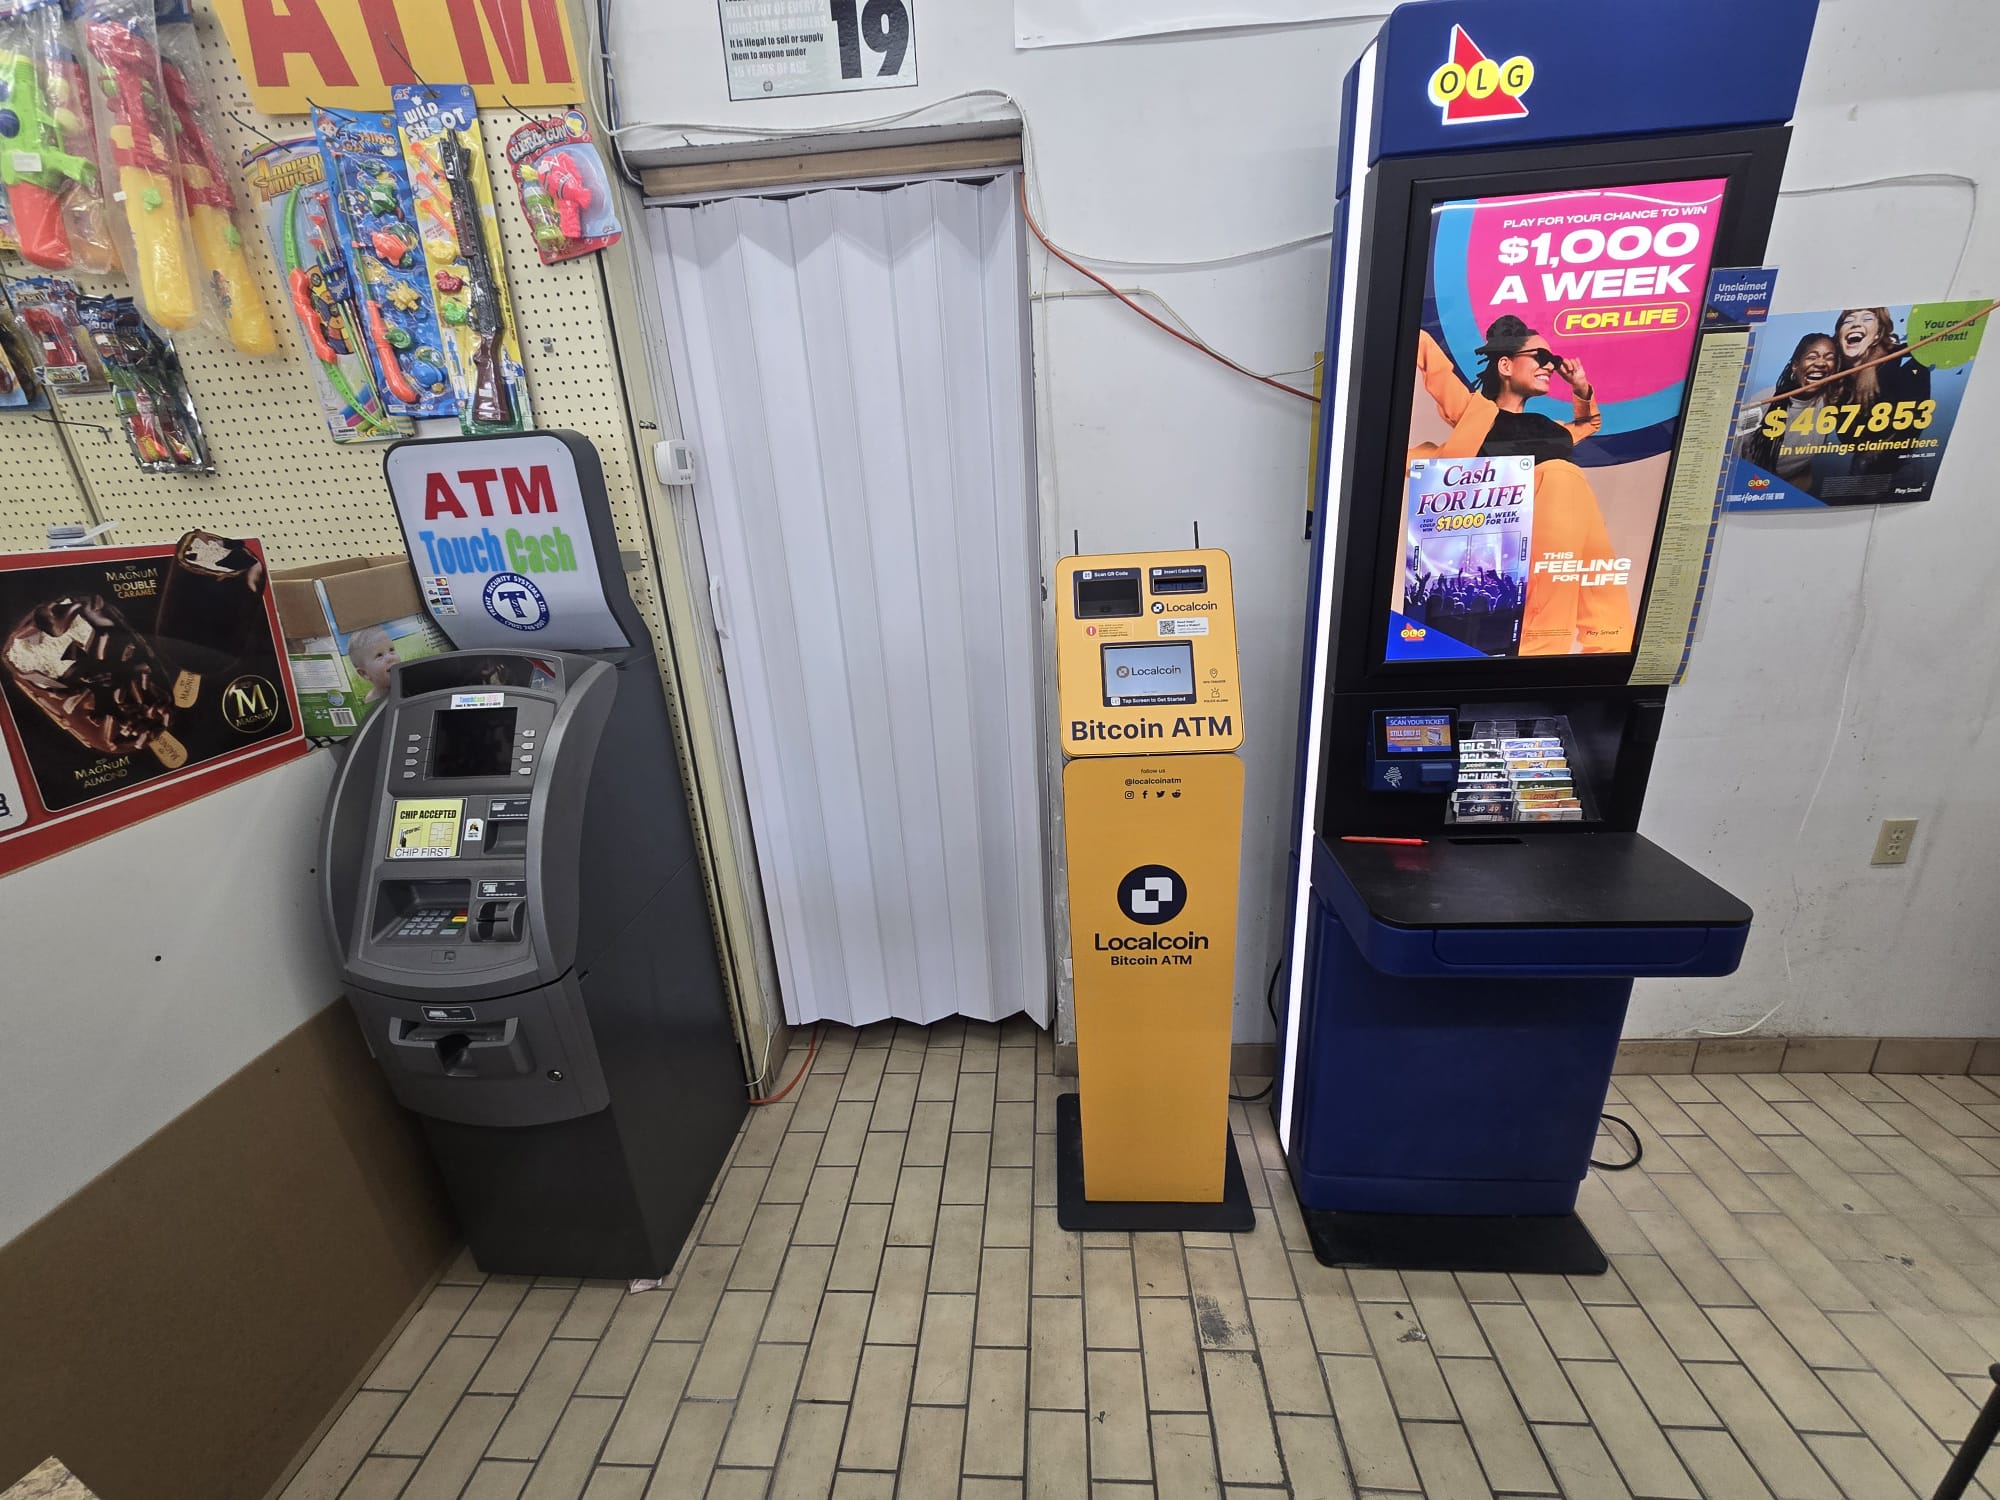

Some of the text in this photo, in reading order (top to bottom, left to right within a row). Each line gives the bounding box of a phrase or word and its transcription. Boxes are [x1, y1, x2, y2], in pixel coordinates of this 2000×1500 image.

[730, 32, 824, 48] It is illegal to sell or supply
[830, 0, 910, 80] 19
[731, 47, 807, 61] them to anyone under
[1440, 64, 1524, 94] OLG
[403, 102, 440, 125] WILD
[546, 126, 567, 144] GUN
[1503, 205, 1708, 229] PLAY FOR YOUR CHANCE TO WIN
[1497, 222, 1700, 269] $1,000
[1489, 263, 1696, 305] A WEEK
[1718, 281, 1768, 292] Unclaimed
[1714, 292, 1767, 304] Prize Report
[1565, 307, 1679, 330] FOR LIFE
[1924, 320, 1945, 330] You
[1940, 331, 1969, 342] next!
[1780, 444, 1792, 456] in
[1794, 441, 1856, 456] winnings
[1857, 438, 1909, 452] claimed
[1443, 460, 1496, 487] Cash
[424, 465, 559, 521] ATM
[1417, 484, 1526, 515] FOR LIFE
[418, 526, 578, 576] Touch Cash
[1543, 552, 1574, 560] THIS
[105, 567, 159, 582] MAGNUM
[1534, 558, 1632, 574] FEELING
[113, 579, 157, 592] DOUBLE
[486, 575, 511, 594] SECURITY
[513, 575, 541, 599] SYSTEMS
[1552, 572, 1629, 586] FOR LIFE
[117, 588, 157, 599] CARAMEL
[485, 596, 497, 617] TRENT
[1166, 600, 1218, 612] Localcoin
[1131, 665, 1182, 676] Localcoin
[231, 684, 270, 719] M
[236, 709, 273, 728] MAGNUM
[1072, 715, 1232, 741] Bitcoin ATM
[74, 755, 131, 780] MAGNUM
[83, 768, 129, 789] ALMOND
[1125, 778, 1182, 786] @localcoinatm
[400, 809, 457, 820] CHIP ACCEPTED
[395, 847, 450, 857] CHIP FIRST
[1094, 931, 1209, 951] Localcoin
[1110, 955, 1192, 966] Bitcoin ATM
